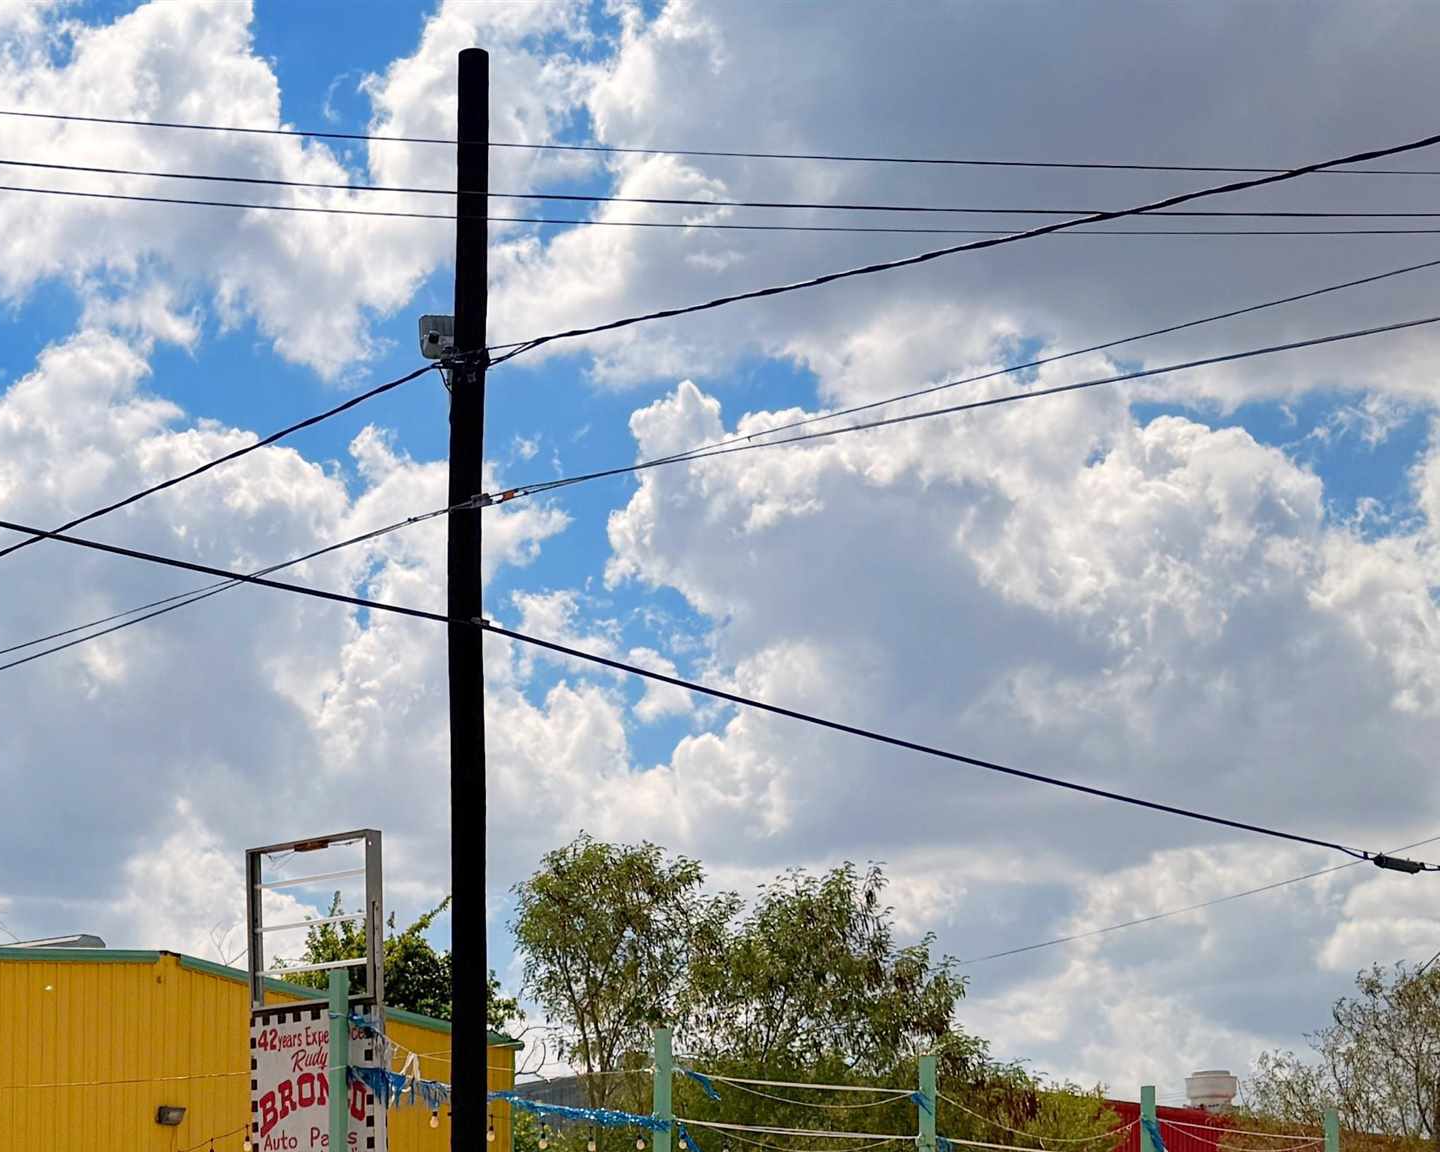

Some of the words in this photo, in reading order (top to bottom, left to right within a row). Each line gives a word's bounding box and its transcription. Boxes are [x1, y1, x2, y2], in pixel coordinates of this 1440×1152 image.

[291, 1046, 328, 1072] Rudy
[259, 1072, 367, 1138] BRONO
[264, 1130, 298, 1151] Auto
[310, 1127, 358, 1148] Pas
